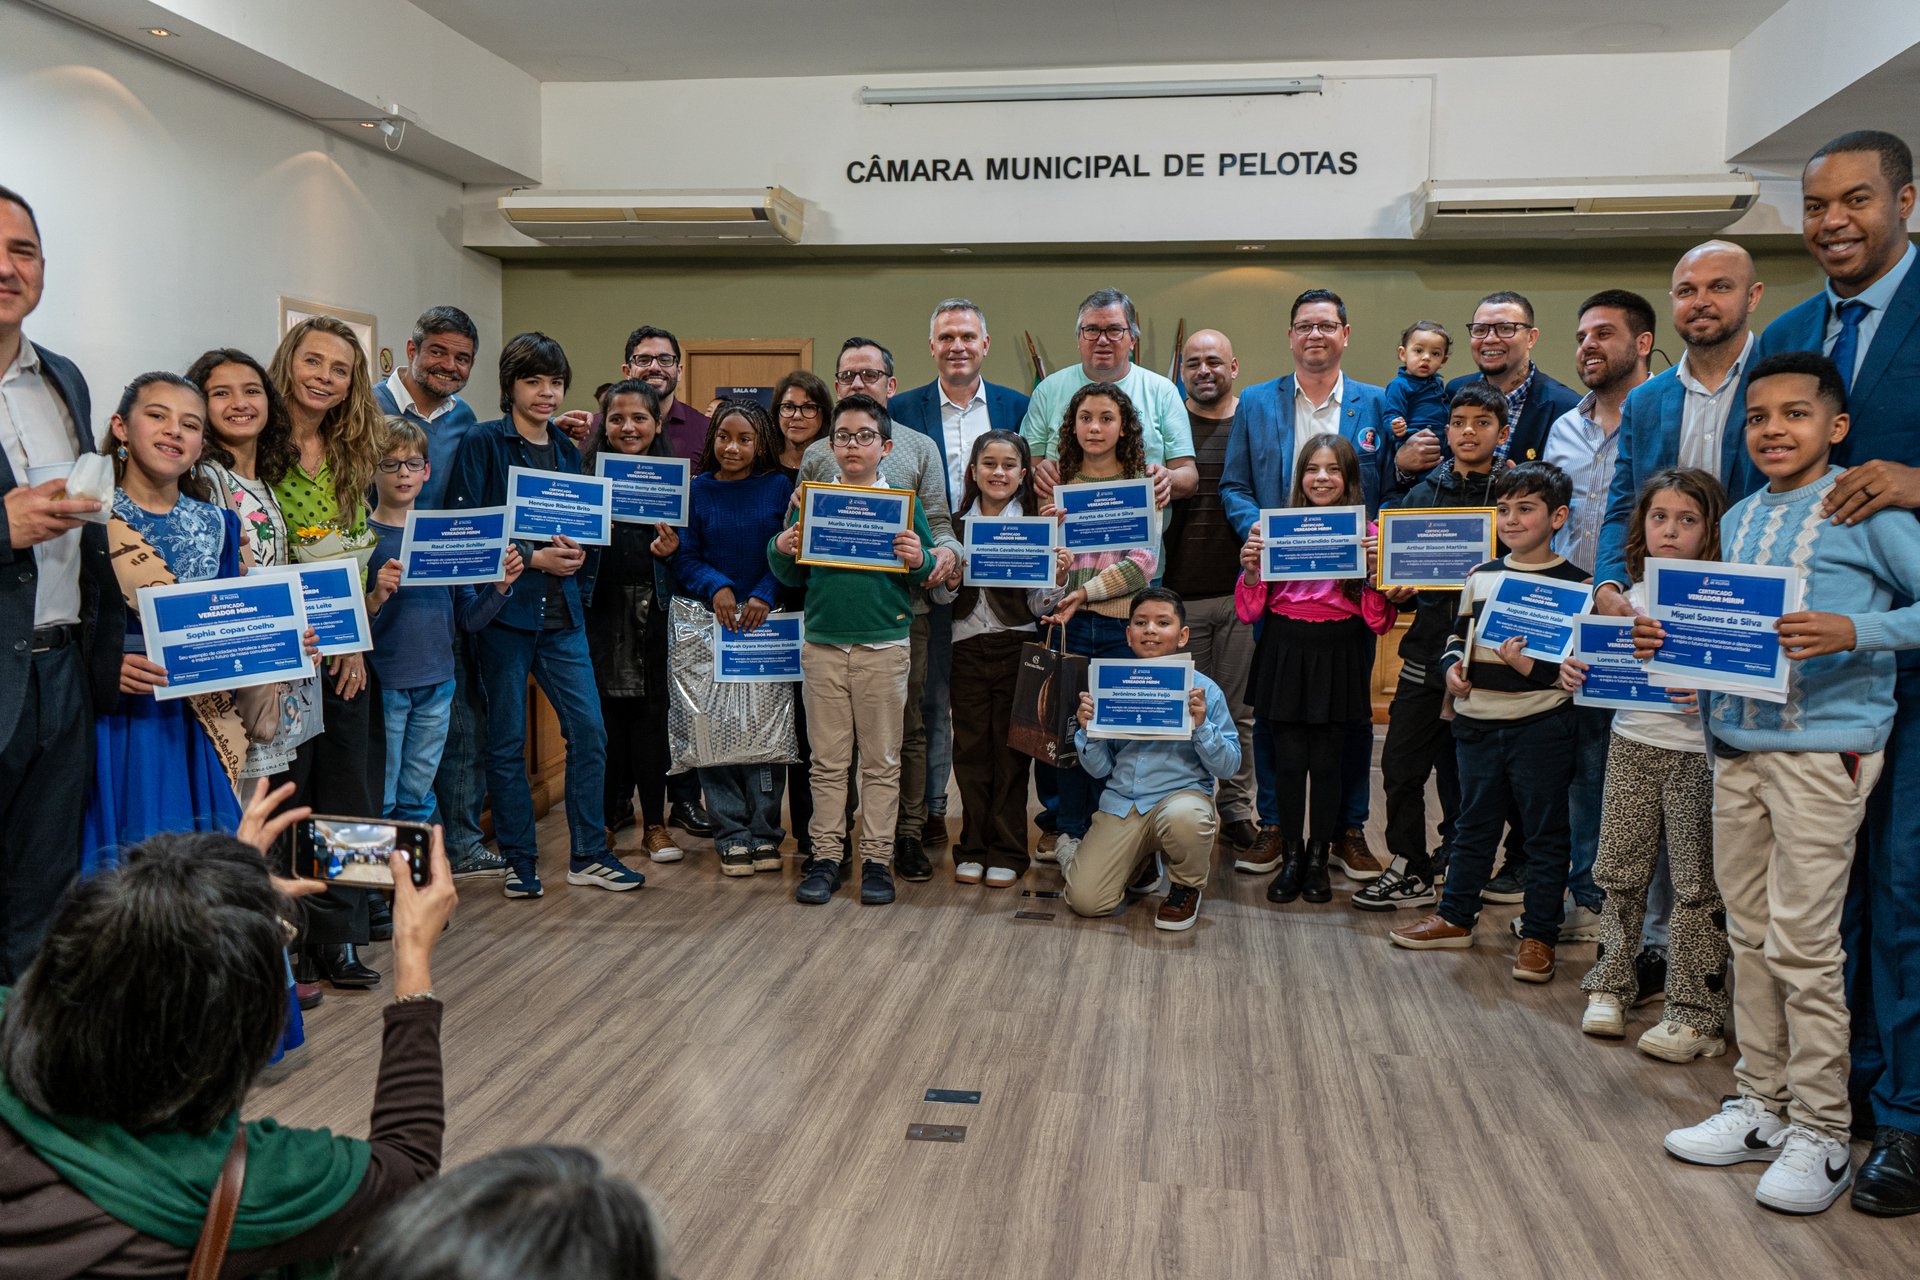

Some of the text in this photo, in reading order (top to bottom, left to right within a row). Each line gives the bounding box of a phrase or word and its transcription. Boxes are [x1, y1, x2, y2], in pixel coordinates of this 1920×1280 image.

[846, 151, 1358, 184] CÂMARA MUNICIPAL DE PELOTAS
[1520, 596, 1545, 604] VEREADOR
[1687, 593, 1721, 602] VEREADOR
[198, 609, 235, 618] VEREADOR
[1505, 607, 1528, 616] Augusto
[1671, 610, 1695, 621] Miguel
[1697, 613, 1724, 623] Soares
[1740, 618, 1761, 627] Silva
[186, 621, 274, 640] Sophia Copas Coelho
